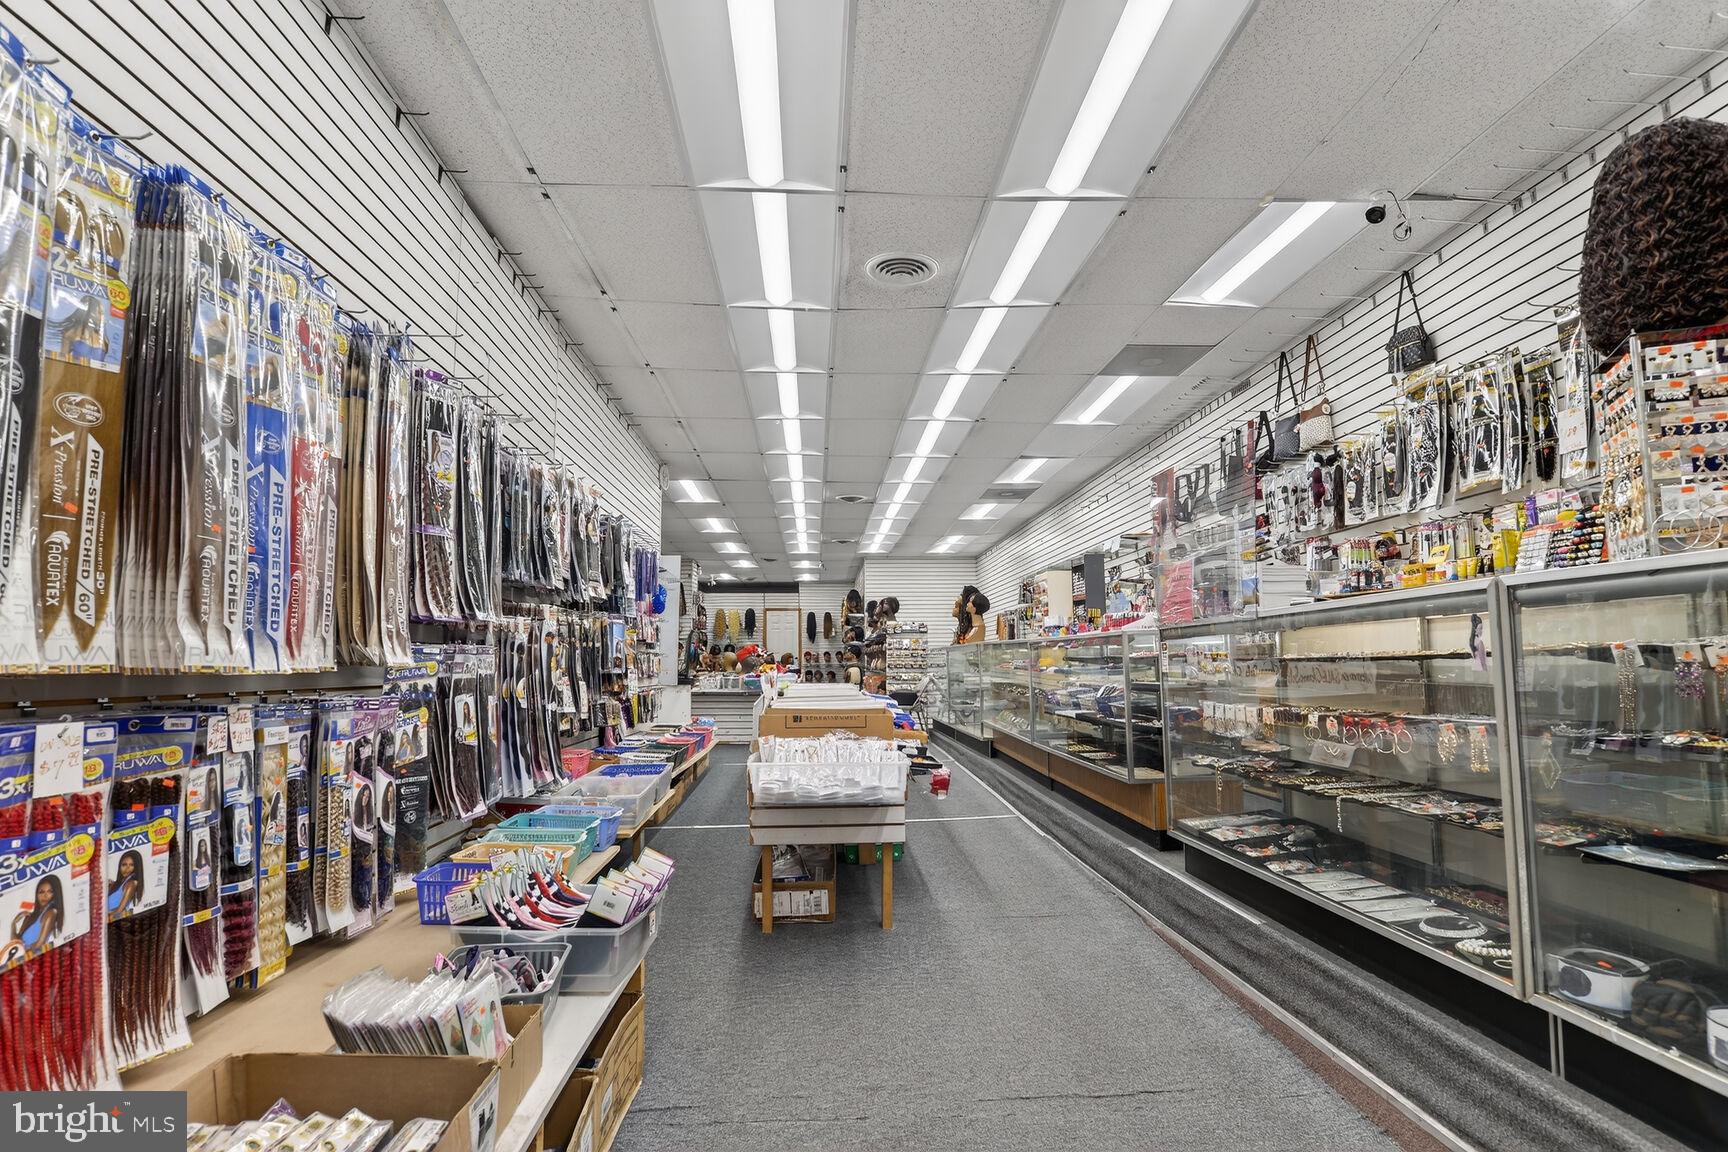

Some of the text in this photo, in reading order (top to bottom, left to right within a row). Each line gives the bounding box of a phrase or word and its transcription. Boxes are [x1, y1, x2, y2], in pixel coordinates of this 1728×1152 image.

[50, 425, 75, 505] X-Pression
[81, 449, 100, 580] PRE-STRETCHED
[46, 544, 62, 606] AQUATEX
[201, 558, 212, 623] AQUATEX
[270, 481, 284, 634] PRE-STRETCHED
